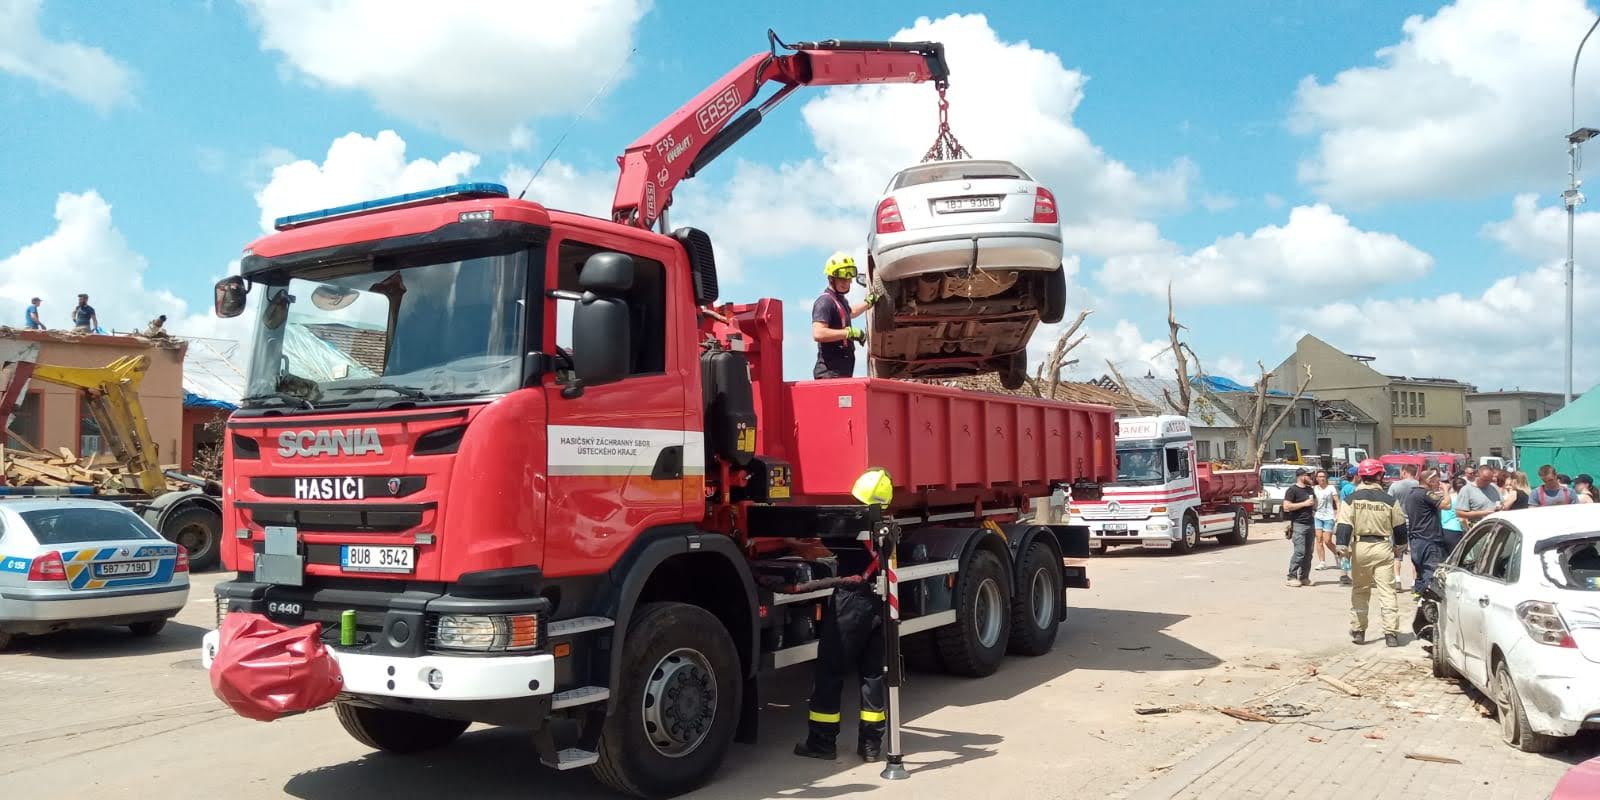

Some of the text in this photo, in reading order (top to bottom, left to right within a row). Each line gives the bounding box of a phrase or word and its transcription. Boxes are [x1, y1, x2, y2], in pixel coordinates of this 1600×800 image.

[698, 88, 739, 130] FASSI
[656, 134, 675, 157] F95
[647, 183, 655, 216] FASSI
[970, 198, 995, 208] 9306
[277, 427, 384, 458] SCANIA
[560, 436, 595, 446] HASIČSKÝ
[617, 448, 637, 456] KRAJE
[294, 476, 364, 500] HASIČI
[350, 547, 408, 566] 8U8 3542
[125, 562, 147, 573] 7190
[268, 603, 301, 615] G 440
